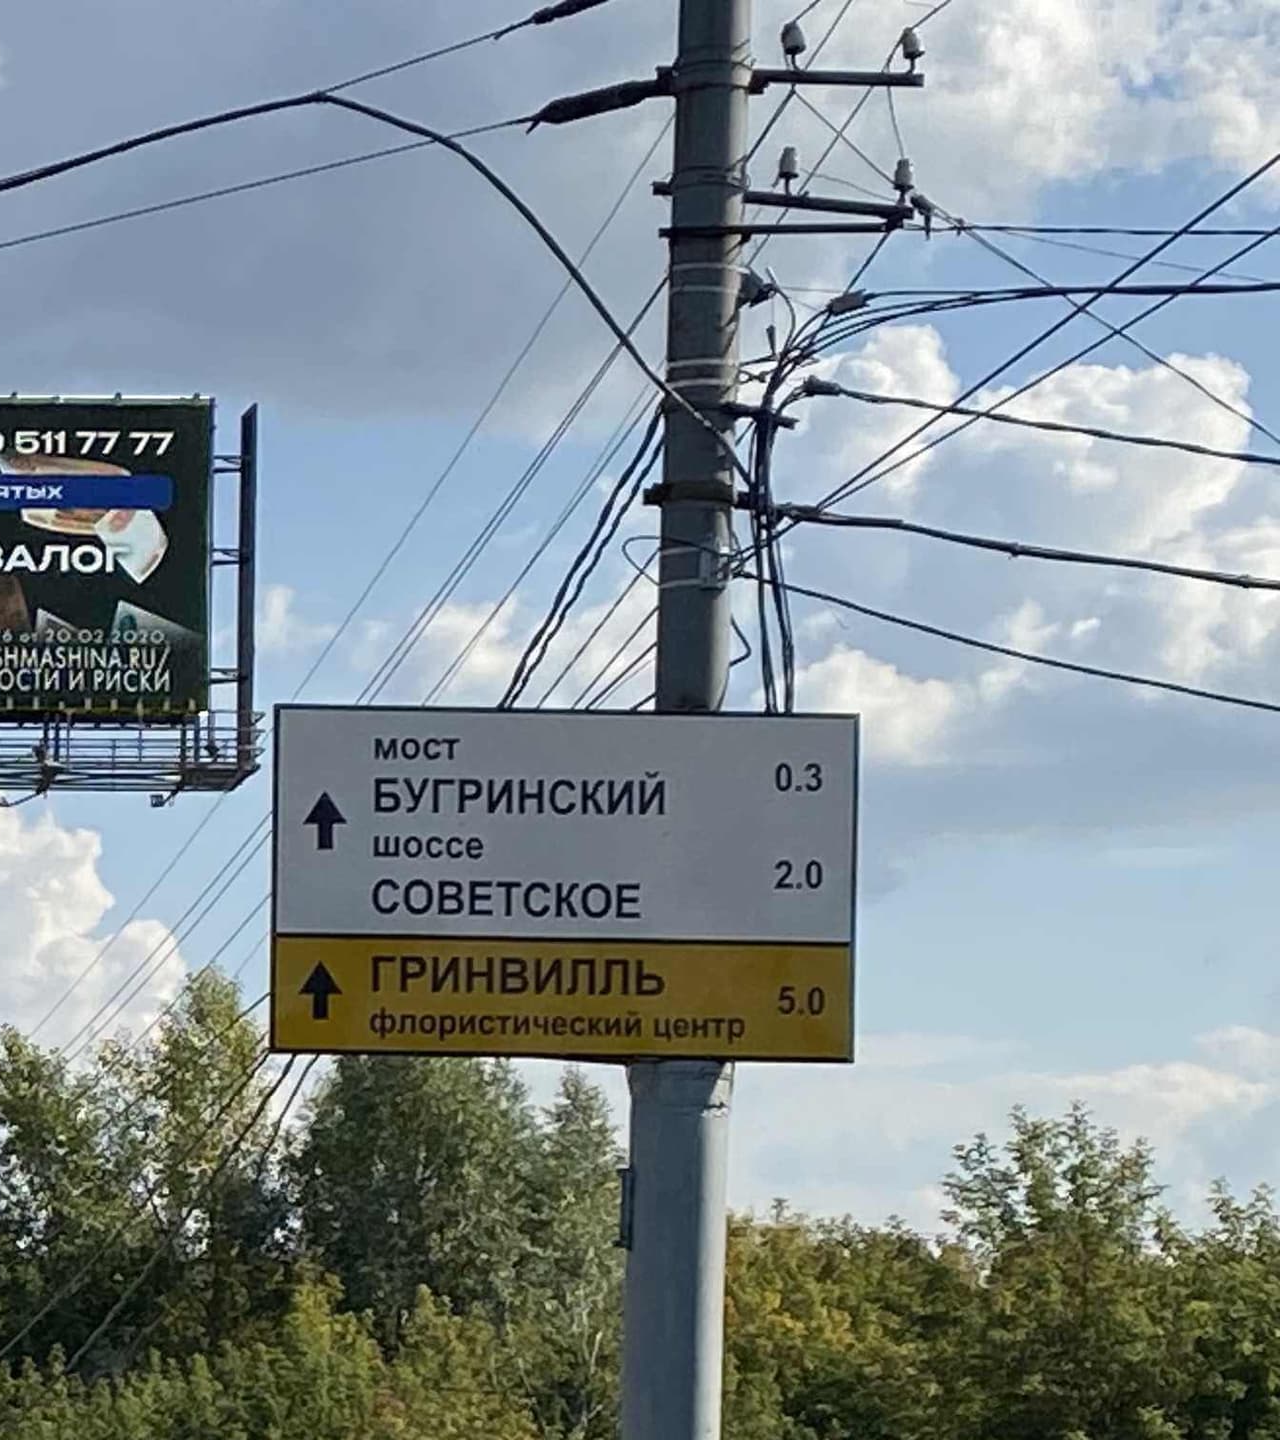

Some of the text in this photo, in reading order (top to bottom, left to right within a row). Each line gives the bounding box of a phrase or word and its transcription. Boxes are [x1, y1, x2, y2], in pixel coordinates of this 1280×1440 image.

[15, 430, 67, 456] 511
[75, 431, 121, 456] 77
[128, 431, 175, 457] 77
[67, 668, 86, 692] И
[92, 669, 172, 693] РИСКИ
[372, 735, 461, 761] мост
[372, 763, 824, 816] БУГРИНСКИЙ 0.3
[372, 834, 484, 861] шоссе
[370, 860, 824, 920] СОВЕТСКОЕ 2.0
[371, 954, 826, 1016] ГРИНВИЛЛЬ 5.0
[369, 1006, 746, 1043] флористический центр
